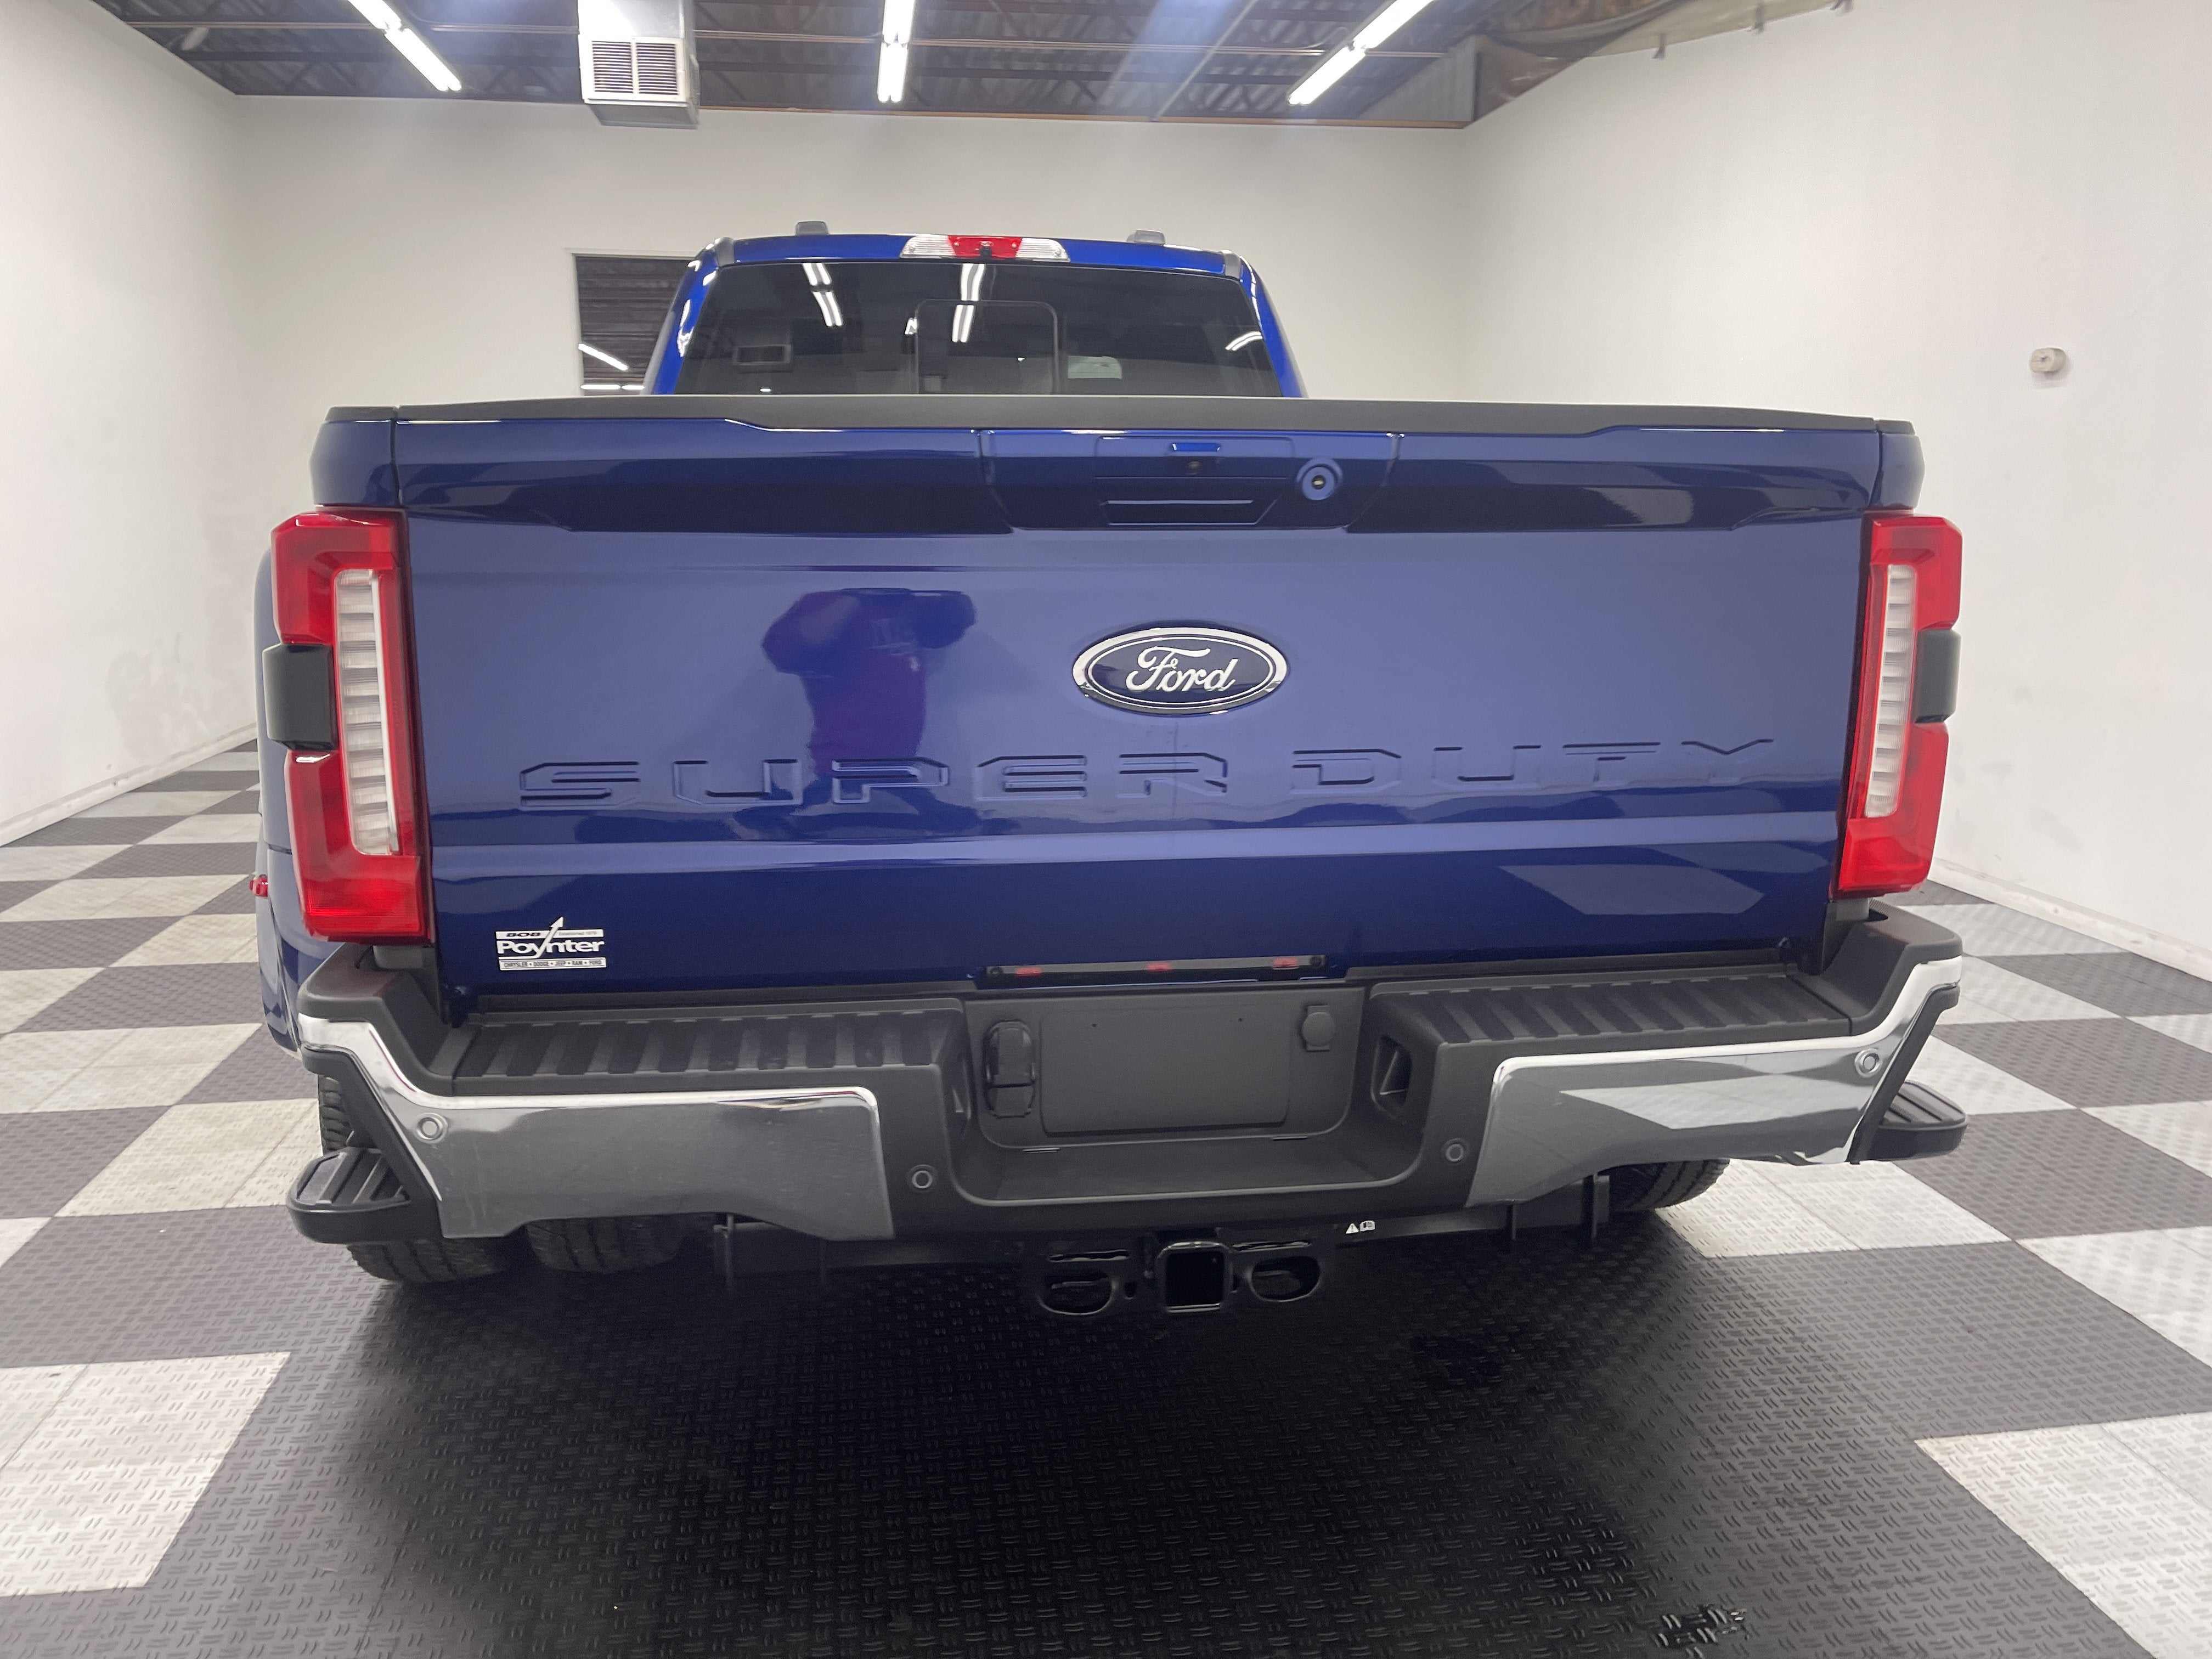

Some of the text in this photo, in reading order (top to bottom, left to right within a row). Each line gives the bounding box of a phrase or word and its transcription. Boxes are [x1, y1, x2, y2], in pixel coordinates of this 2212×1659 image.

[1126, 646, 1238, 692] Ford
[519, 737, 1774, 810] SUPER DUTY
[496, 940, 605, 953] Poynter
